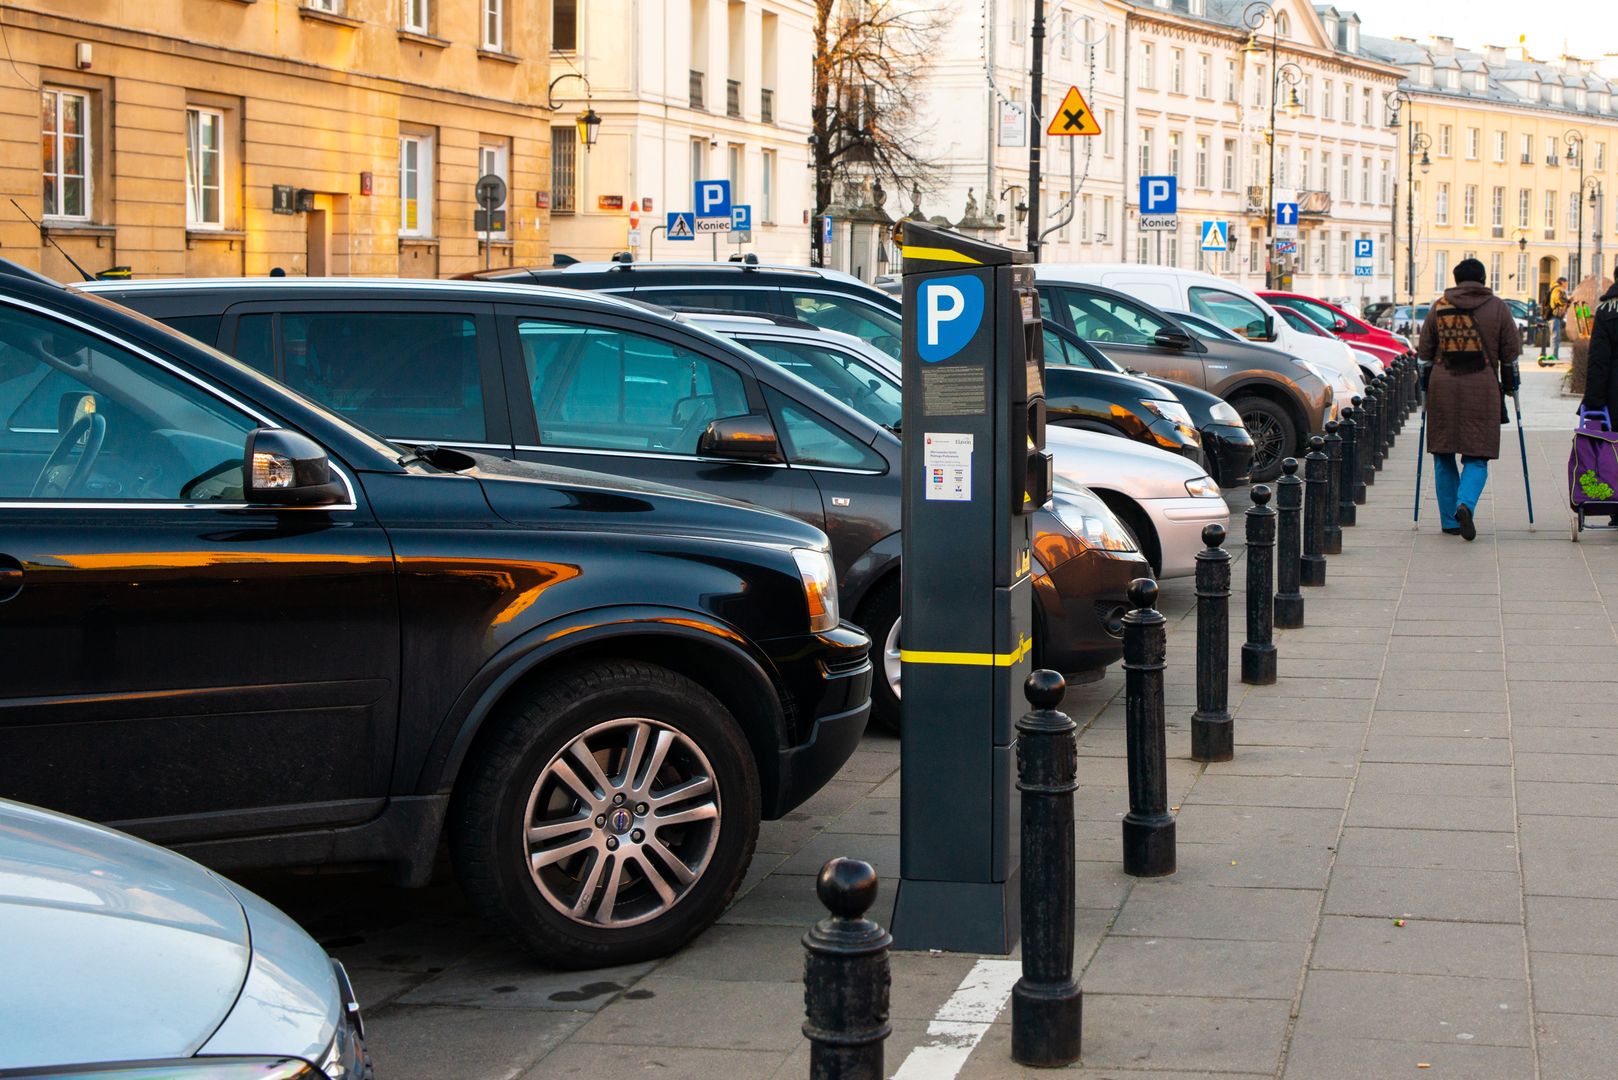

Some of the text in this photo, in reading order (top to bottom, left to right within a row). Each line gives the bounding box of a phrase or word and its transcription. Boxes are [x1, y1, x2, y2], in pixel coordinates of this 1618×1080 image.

[703, 184, 723, 213] P
[1148, 180, 1169, 210] P
[733, 208, 746, 228] P
[1142, 218, 1175, 227] Koniec
[697, 221, 730, 230] Koniec
[1277, 242, 1296, 252] TAXI
[1359, 241, 1369, 255] P
[1356, 267, 1373, 275] TAXI
[927, 285, 965, 345] P
